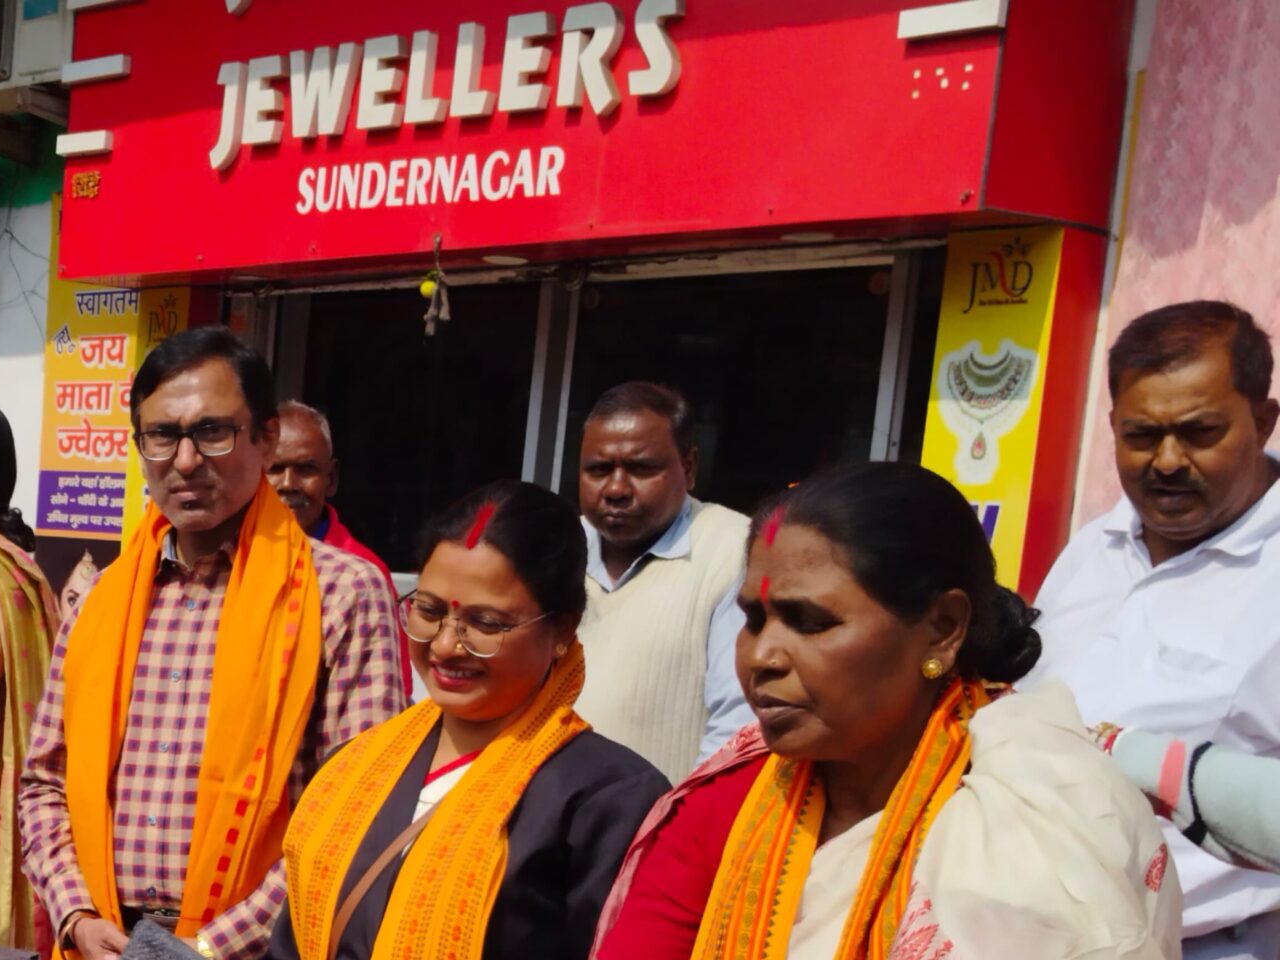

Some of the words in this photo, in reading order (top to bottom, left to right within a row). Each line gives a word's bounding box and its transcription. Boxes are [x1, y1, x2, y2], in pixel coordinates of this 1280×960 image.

[209, 0, 685, 171] JEWELLERS
[295, 146, 565, 215] SUNDERNAGAR
[78, 334, 128, 366] जय
[56, 382, 113, 411] माता
